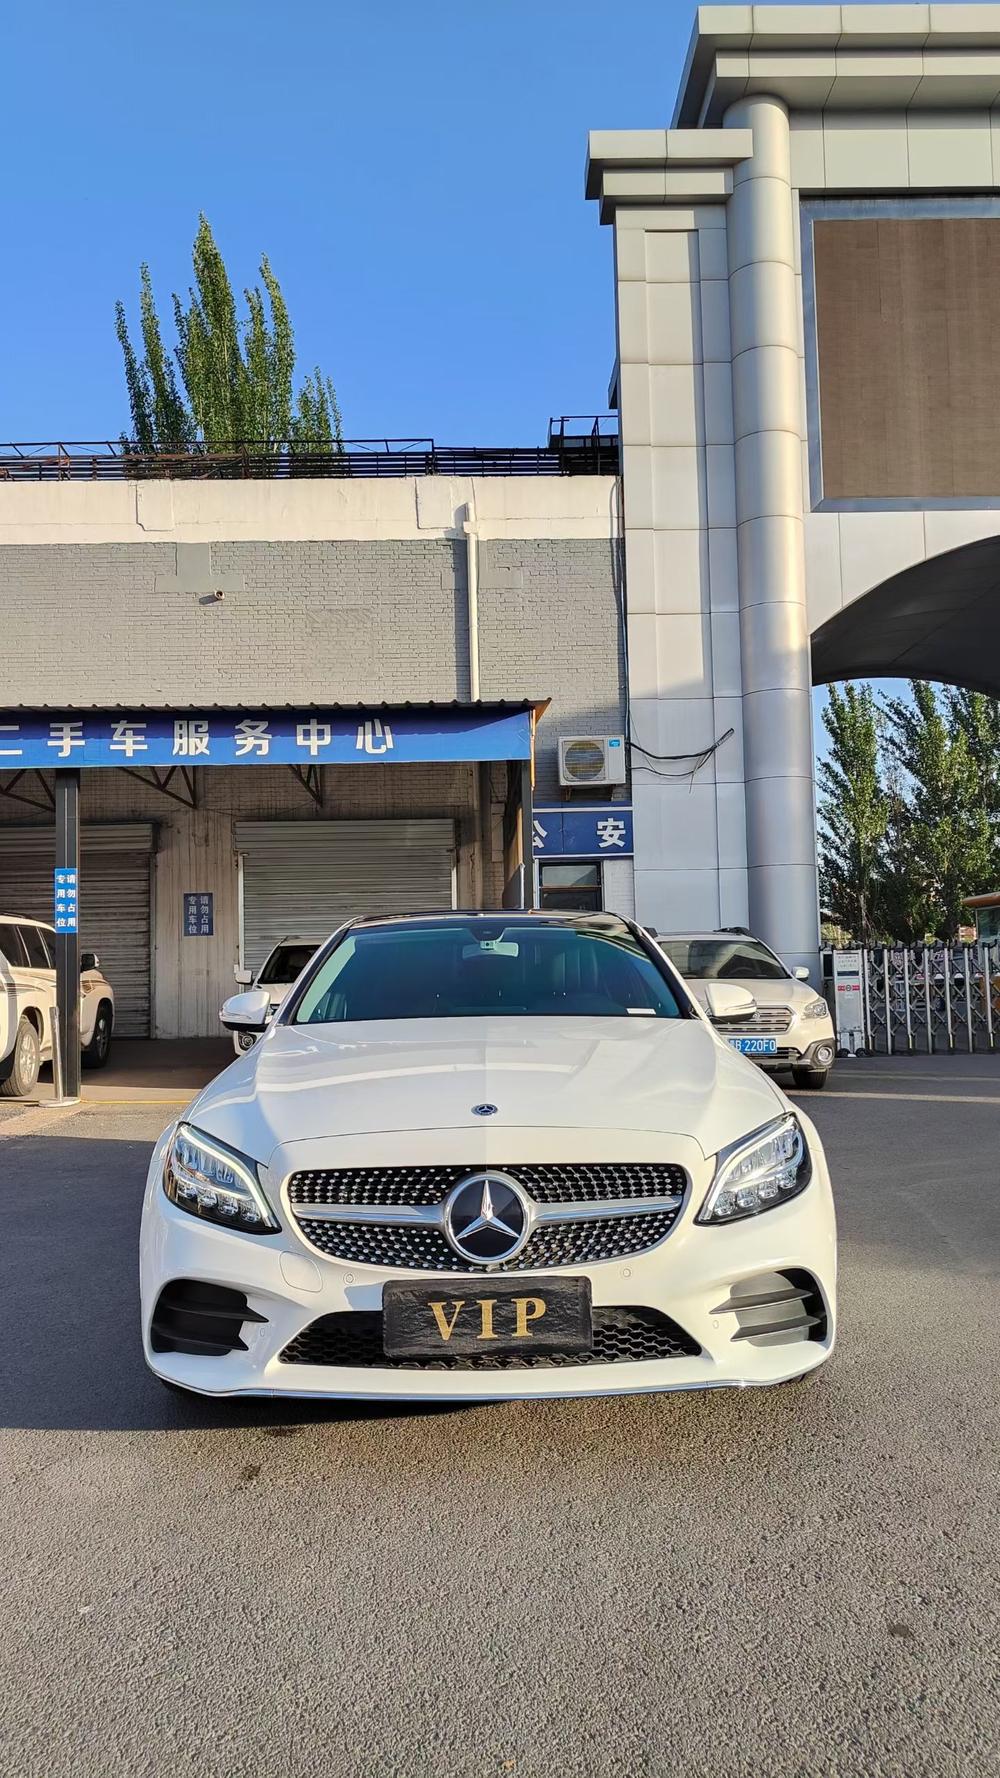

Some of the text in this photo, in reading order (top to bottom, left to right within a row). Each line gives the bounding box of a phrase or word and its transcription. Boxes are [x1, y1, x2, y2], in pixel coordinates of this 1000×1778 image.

[0, 718, 394, 757] 二手车服务中心
[56, 875, 66, 927] 专用车位
[67, 874, 76, 927] 请勿占用
[188, 896, 197, 934] 专用车位
[200, 896, 209, 934] 请勿占用
[428, 1298, 547, 1341] VIP
